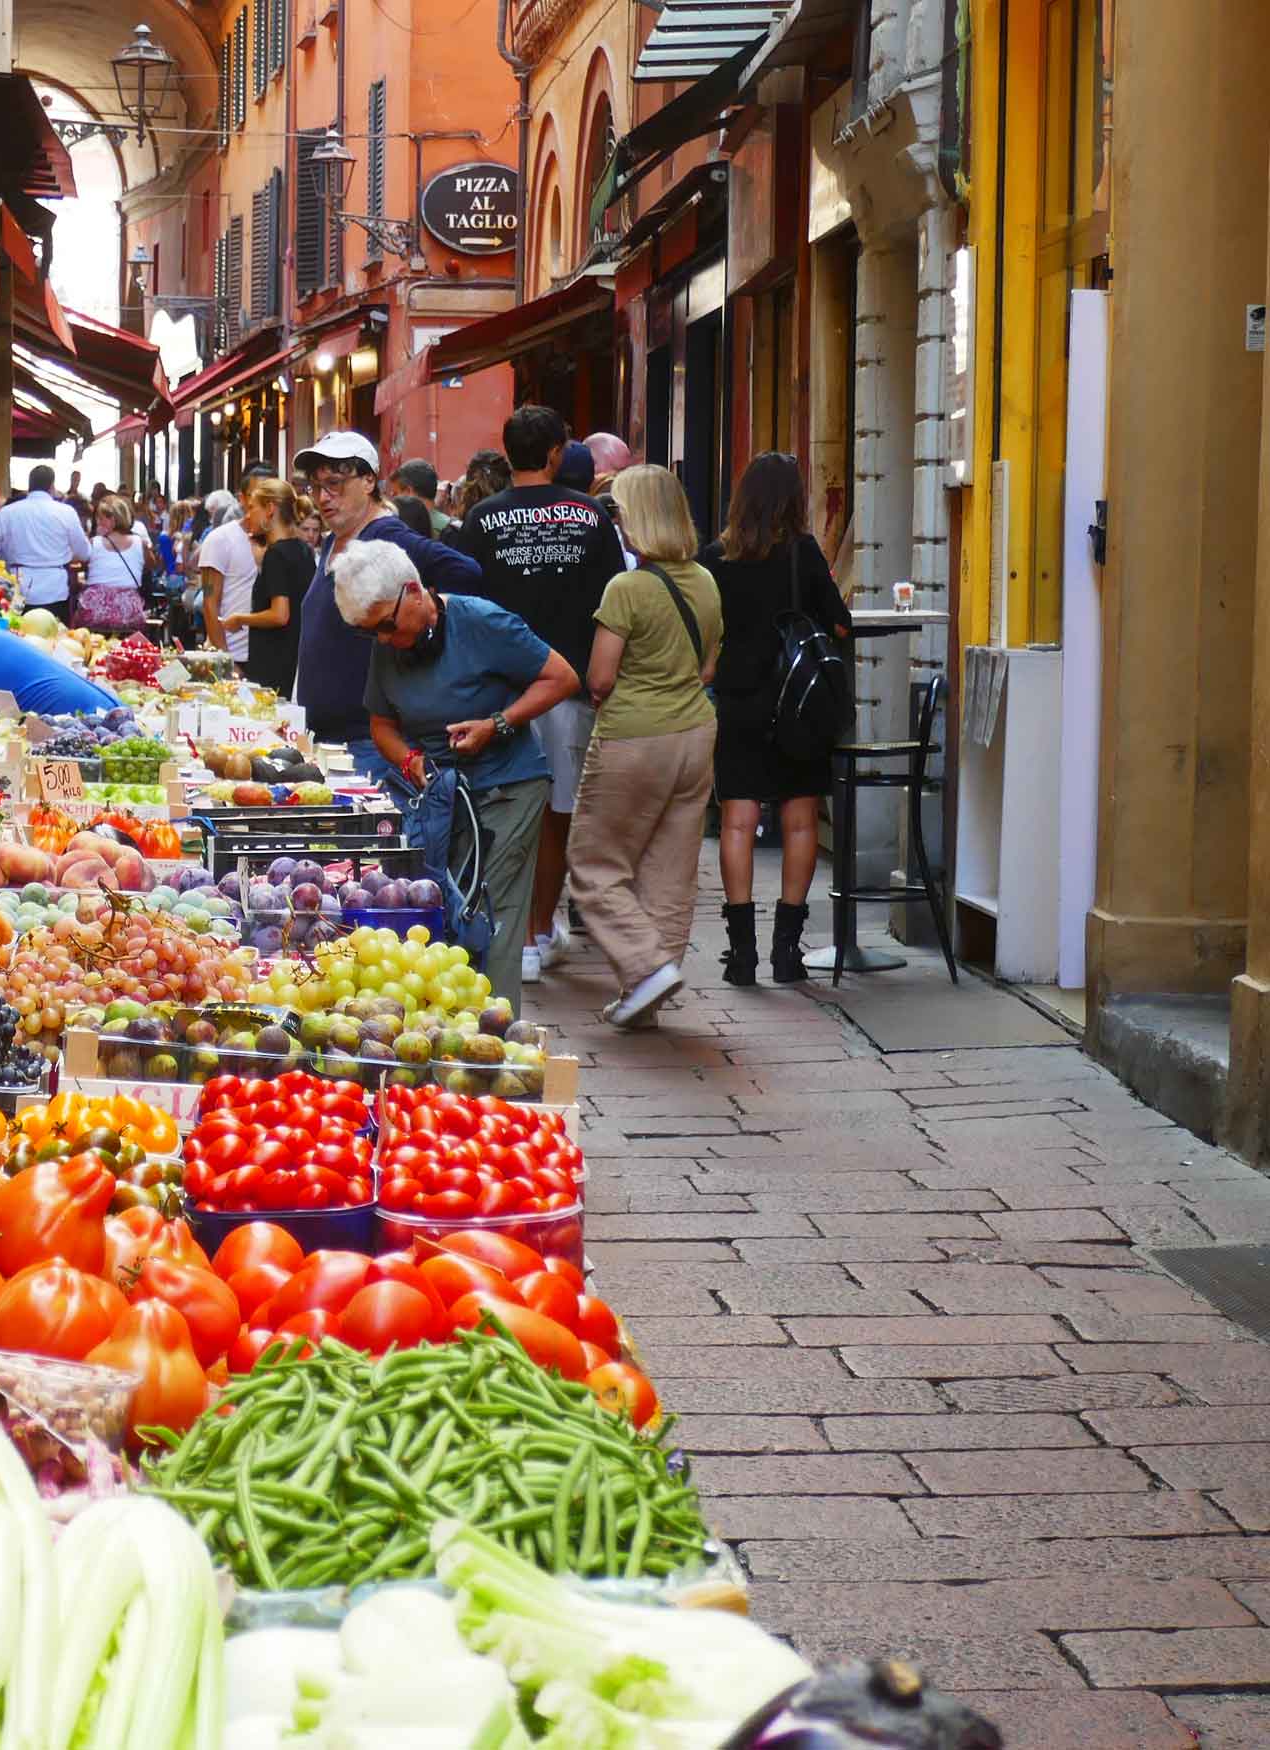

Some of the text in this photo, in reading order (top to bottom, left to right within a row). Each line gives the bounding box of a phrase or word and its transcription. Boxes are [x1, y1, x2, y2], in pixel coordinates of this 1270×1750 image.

[455, 177, 510, 193] PIZZA
[470, 196, 495, 210] AL
[445, 213, 518, 229] TAGLIO
[480, 505, 599, 533] MARATHON SEASON
[505, 553, 580, 566] WAVE OF EFFORTS
